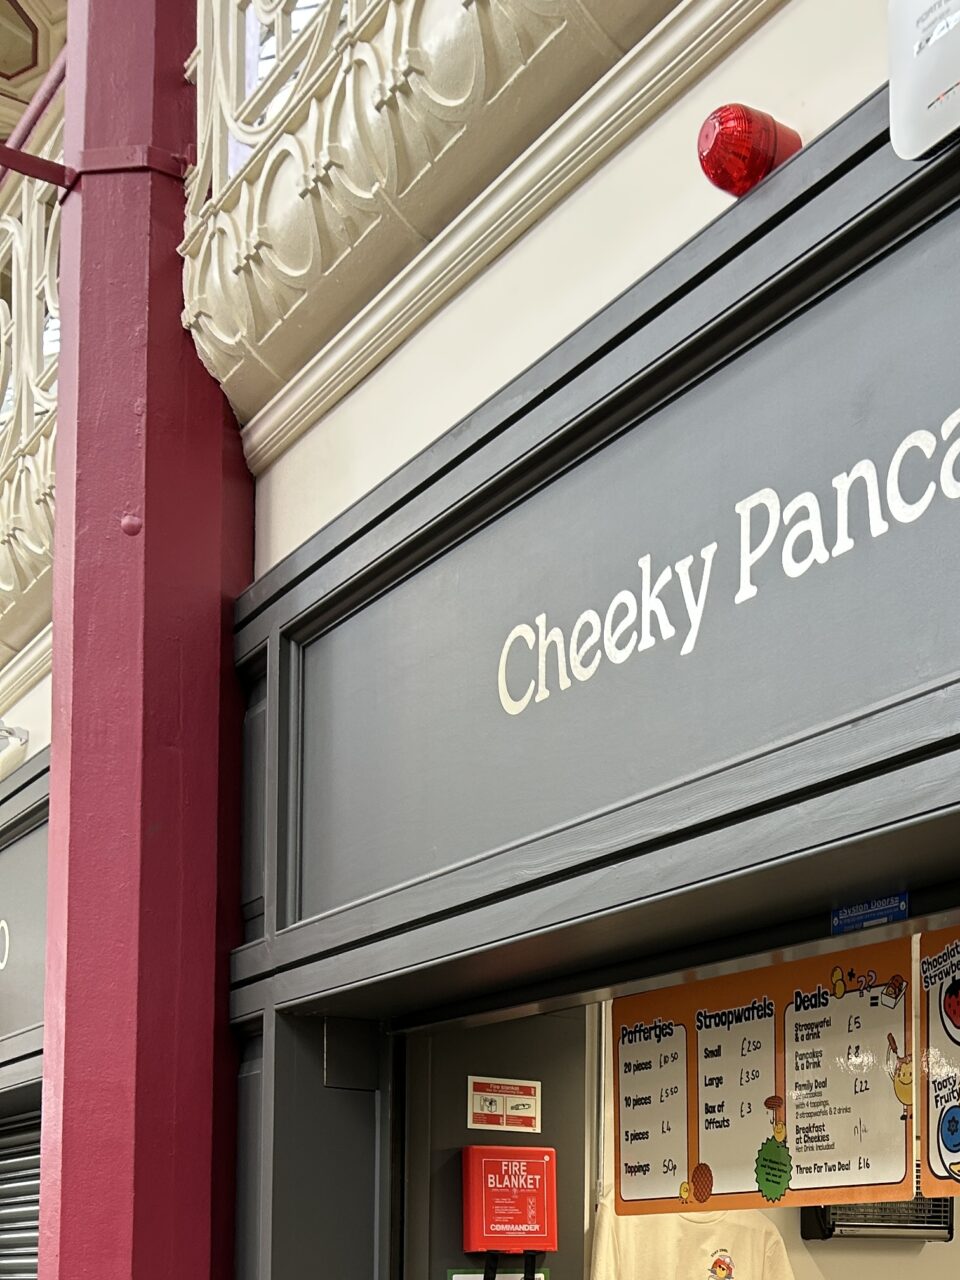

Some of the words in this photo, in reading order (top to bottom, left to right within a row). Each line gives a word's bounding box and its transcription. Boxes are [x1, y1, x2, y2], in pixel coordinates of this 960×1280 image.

[498, 541, 718, 715] Cheeky
[794, 986, 829, 1012] Deals
[696, 997, 774, 1031] Stroopwafels
[621, 1018, 673, 1045] Poffertjes
[794, 1016, 832, 1032] Stroopwafel
[806, 1030, 821, 1041] drink
[704, 1045, 721, 1059] Small
[795, 1049, 823, 1061] Pancakes
[624, 1061, 631, 1073] 20
[633, 1060, 652, 1075] pieces
[806, 1059, 821, 1070] Drink
[704, 1075, 723, 1088] Large
[794, 1080, 813, 1092] Family
[815, 1077, 827, 1089] Deal
[854, 1077, 870, 1095] £22
[932, 1073, 956, 1093] Tooty
[624, 1095, 631, 1108] 10
[632, 1094, 652, 1109] pieces
[934, 1087, 960, 1109] Fruity
[705, 1102, 715, 1114] Box
[717, 1100, 725, 1113] of
[704, 1117, 731, 1130] Offcuts
[795, 1122, 825, 1135] Breakfast
[625, 1130, 630, 1141] 5
[630, 1129, 649, 1144] pieces
[796, 1136, 802, 1145] at
[803, 1134, 830, 1144] Cheekies
[502, 1161, 527, 1175] FIRE
[624, 1161, 650, 1177] Toppings
[662, 1158, 677, 1176] 50p
[796, 1164, 812, 1174] Three
[813, 1163, 823, 1173] For
[824, 1162, 837, 1173] Two
[838, 1160, 851, 1171] Deal
[488, 1173, 541, 1189] BLANKET
[490, 1224, 541, 1232] COMMANDER
